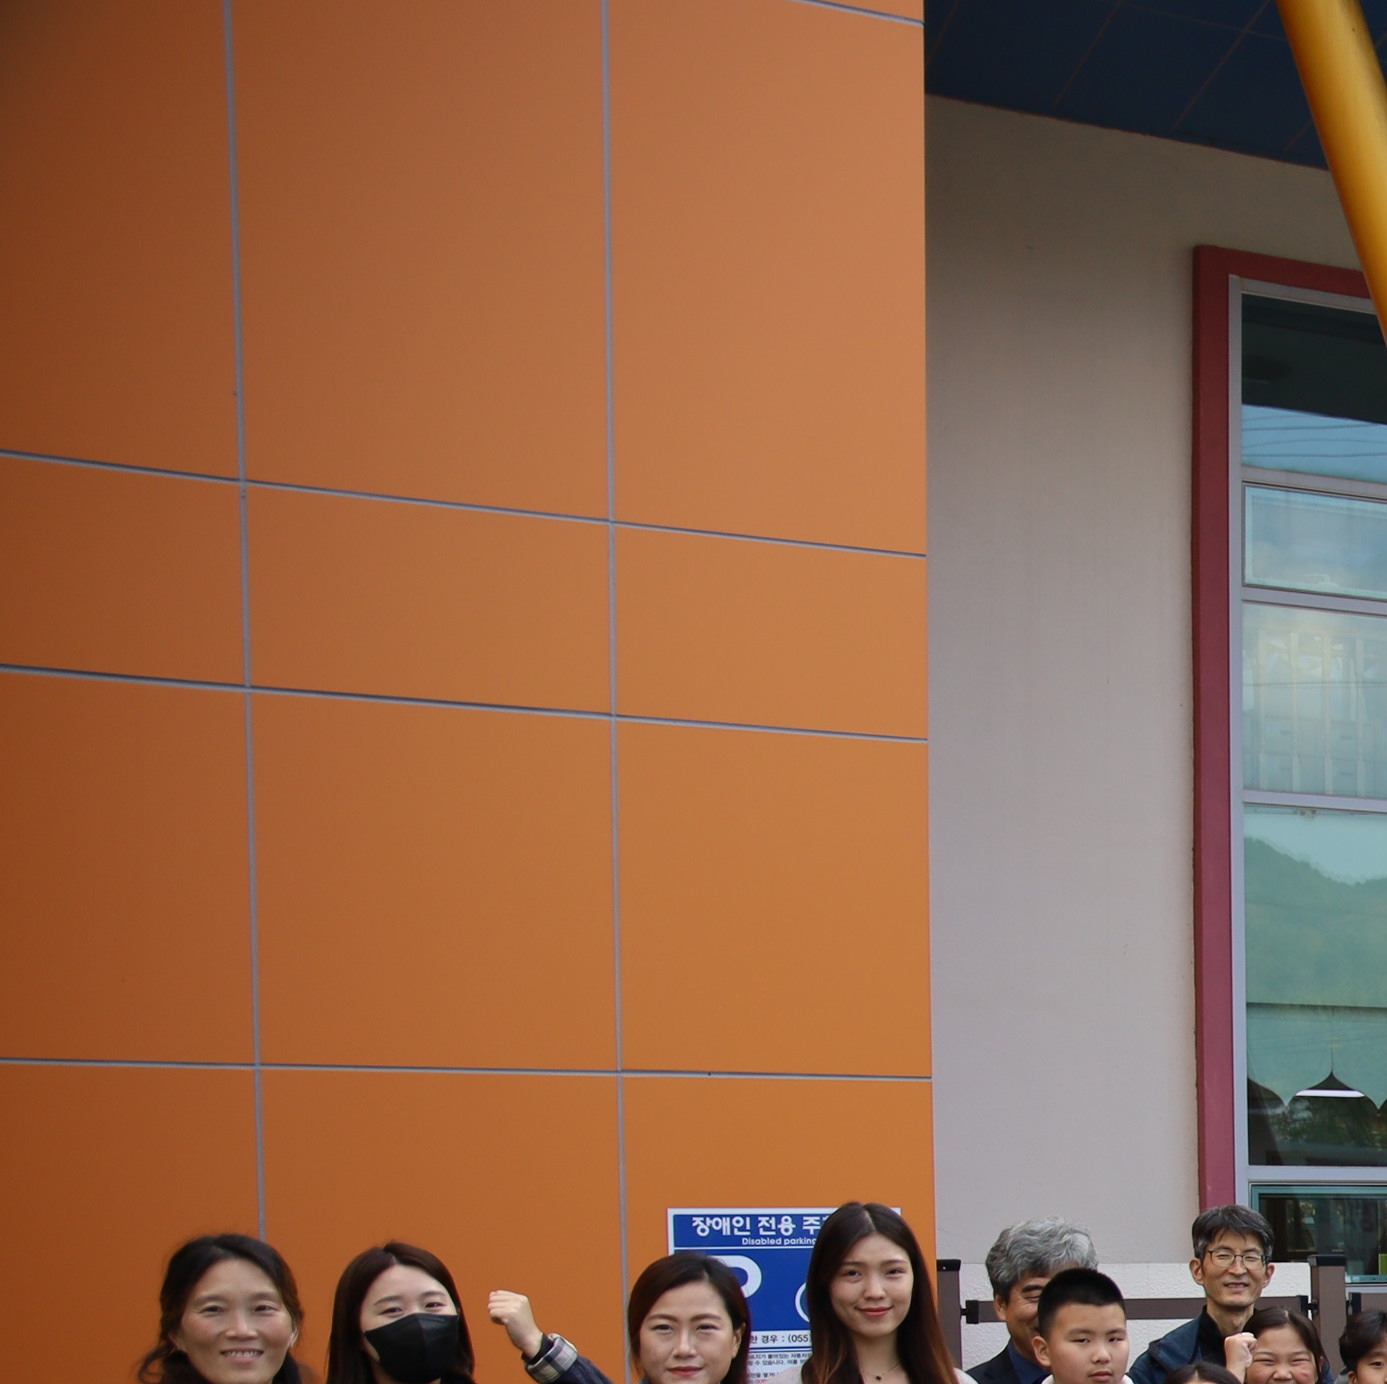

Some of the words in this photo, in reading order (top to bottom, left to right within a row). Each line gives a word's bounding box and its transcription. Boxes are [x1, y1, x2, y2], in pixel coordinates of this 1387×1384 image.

[692, 1216, 751, 1237] 장애인
[757, 1215, 796, 1236] 전용
[741, 1237, 782, 1246] Disabled
[761, 1334, 778, 1344] 경우
